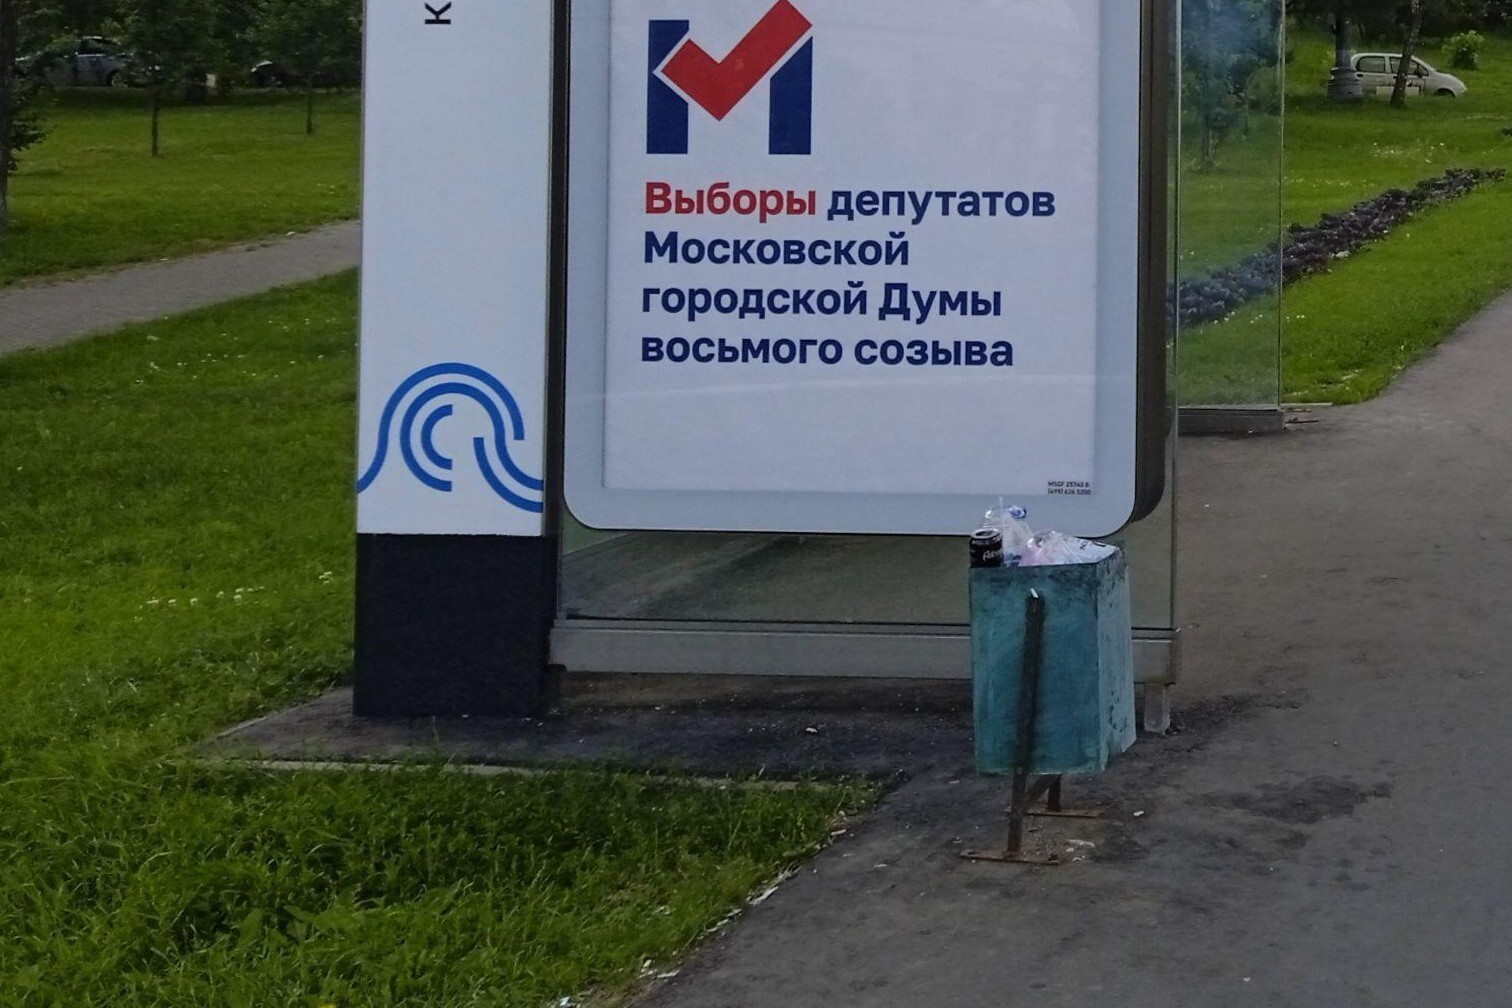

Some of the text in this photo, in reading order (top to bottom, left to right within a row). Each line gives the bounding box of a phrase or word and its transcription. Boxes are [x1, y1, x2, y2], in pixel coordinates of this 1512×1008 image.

[644, 181, 1056, 226] Выборы депутатов
[643, 230, 909, 266] Московской
[641, 280, 1002, 325] городской Думы
[641, 333, 1014, 367] восьмого созыва
